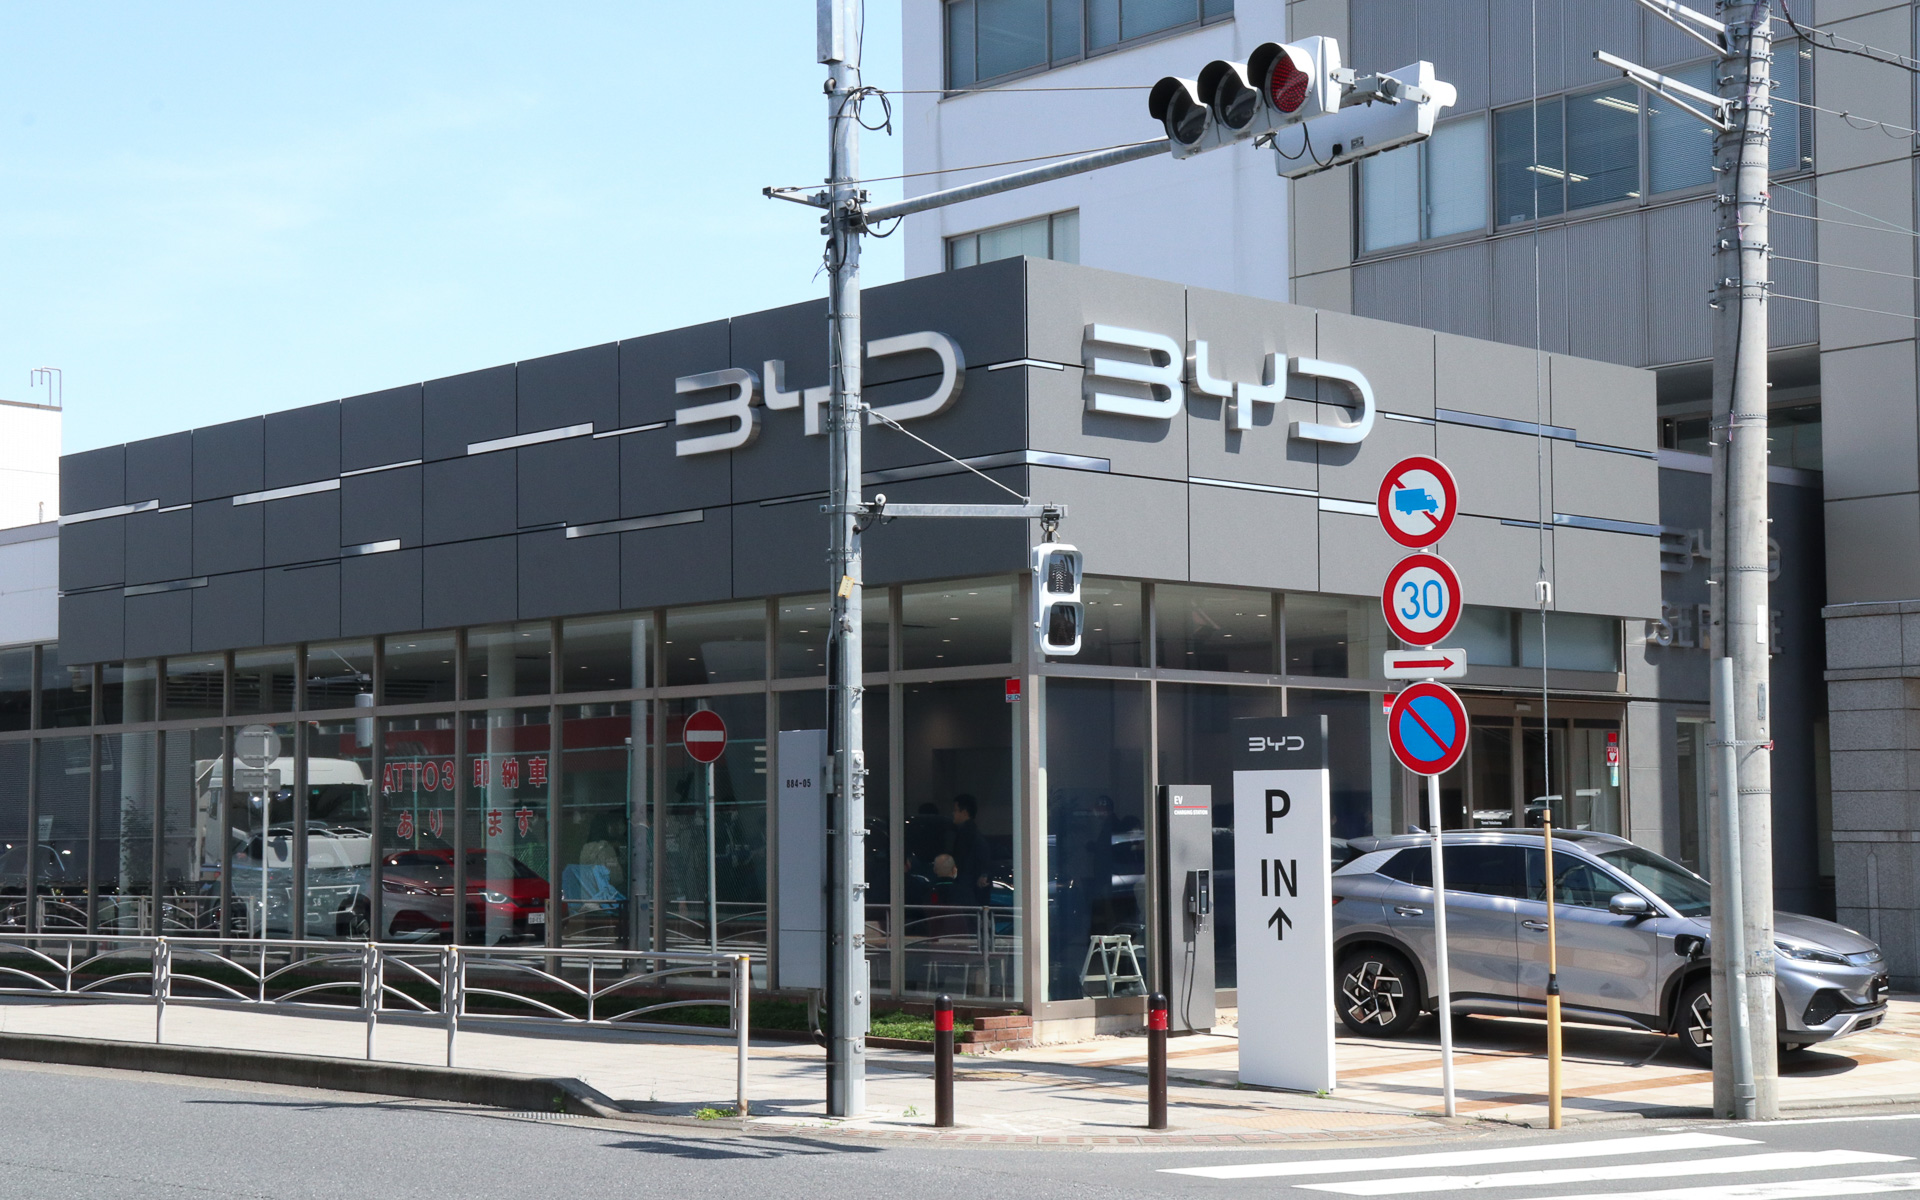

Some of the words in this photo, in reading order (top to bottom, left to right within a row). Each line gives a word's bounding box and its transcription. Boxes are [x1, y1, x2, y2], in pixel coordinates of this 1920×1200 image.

[675, 330, 966, 457] BYD
[1085, 323, 1376, 444] BYD
[1401, 579, 1444, 620] 30
[1249, 736, 1304, 752] BYD
[473, 756, 548, 789] 即納車
[786, 779, 811, 788] 884-05
[1173, 795, 1183, 805] EV
[1265, 789, 1291, 834] P
[1261, 859, 1298, 898] IN
